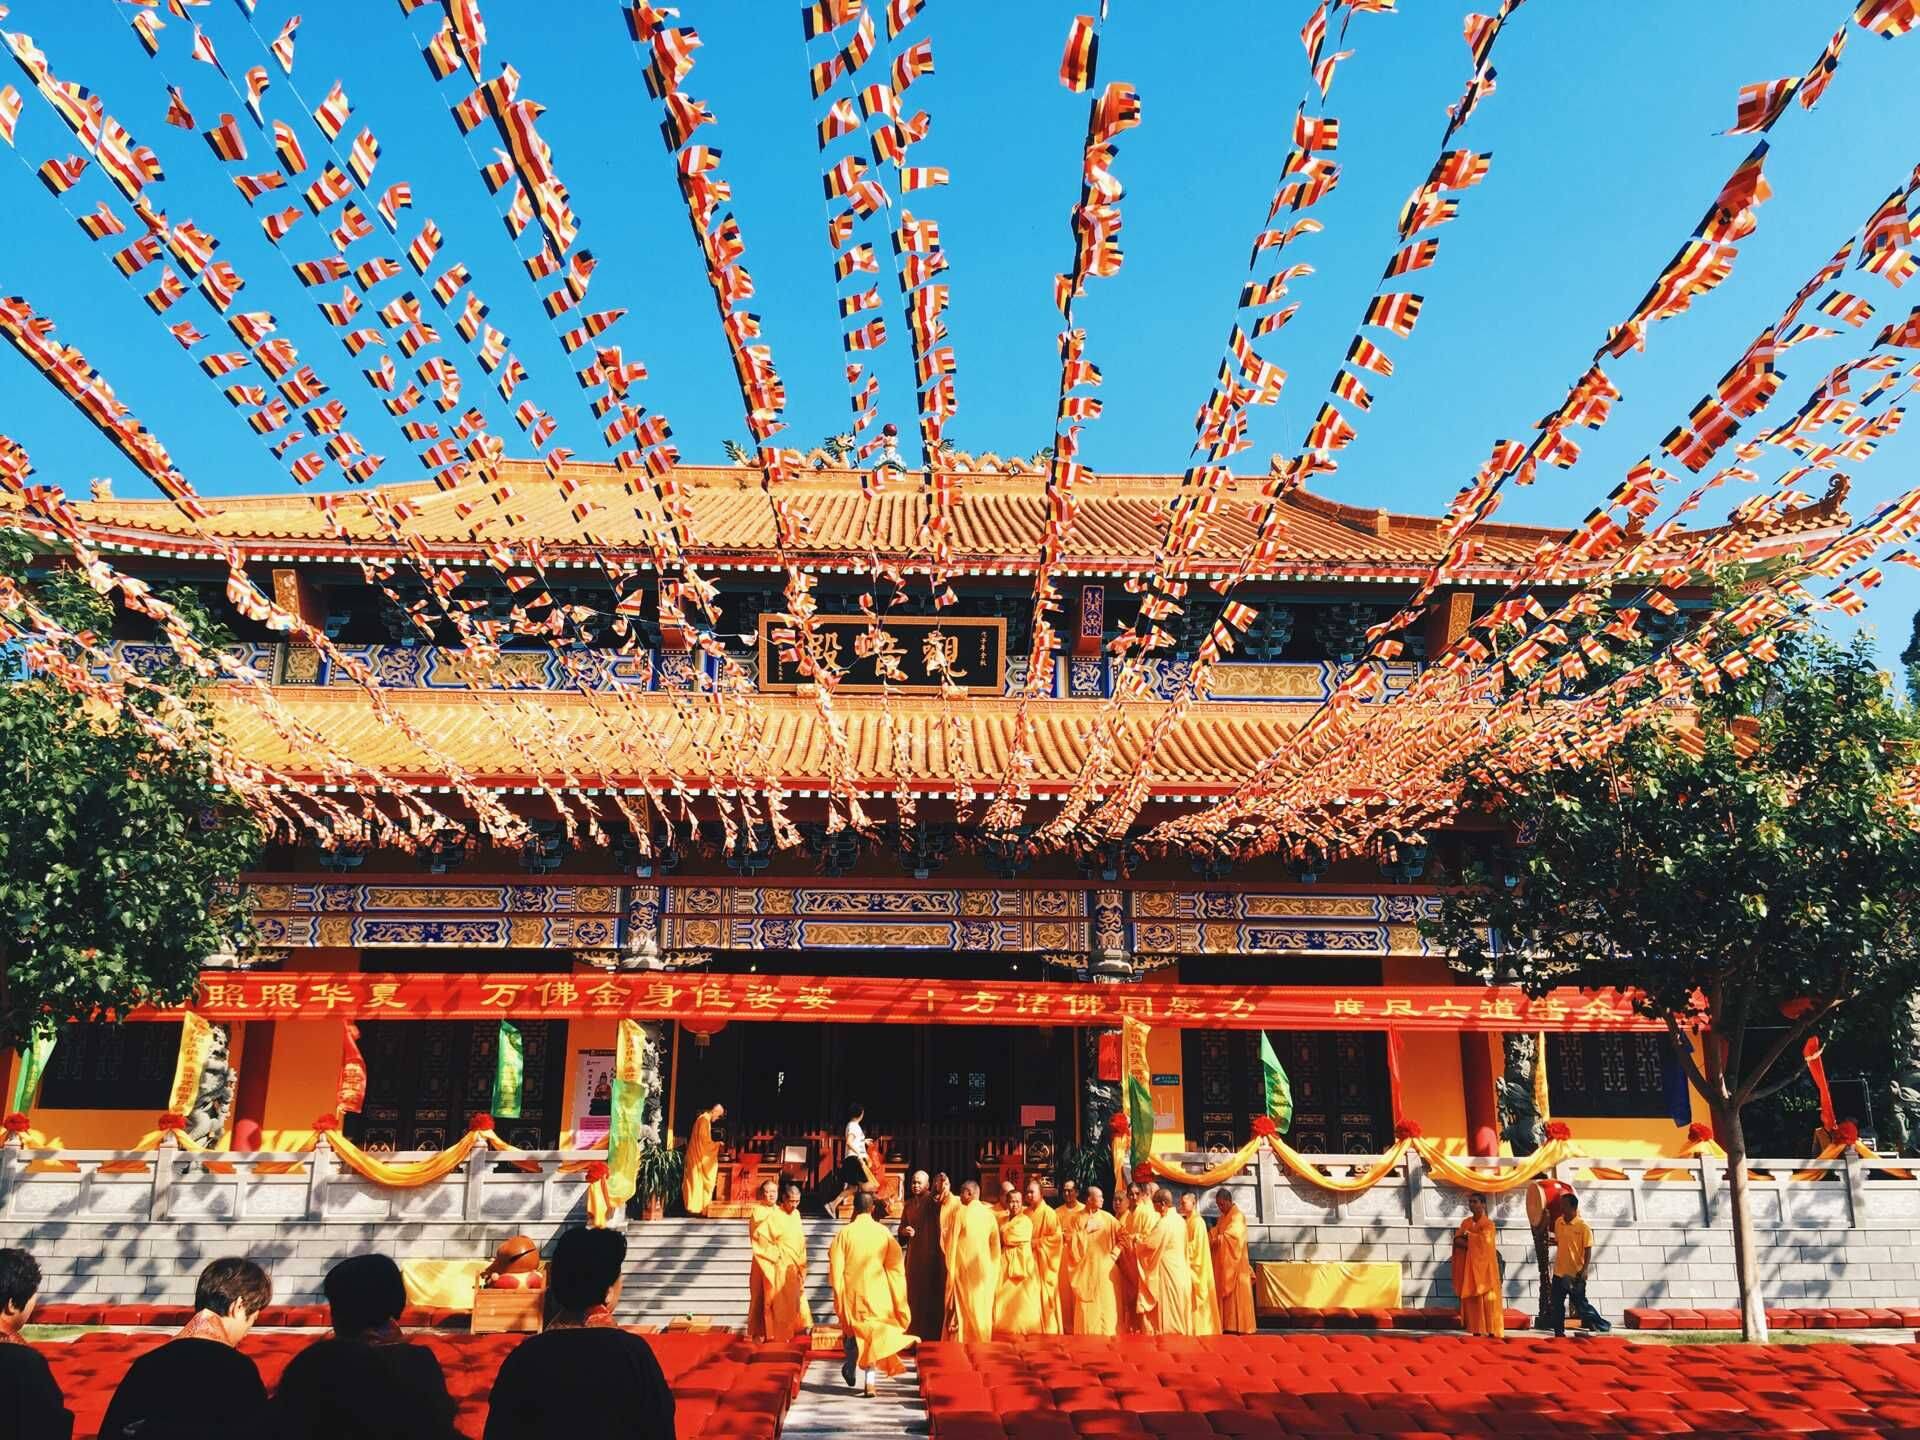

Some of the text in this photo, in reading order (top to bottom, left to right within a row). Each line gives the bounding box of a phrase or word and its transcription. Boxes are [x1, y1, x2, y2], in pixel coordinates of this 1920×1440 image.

[168, 982, 407, 1009] 照照华夏
[480, 981, 838, 1010] 万佛金身住娑婆
[1333, 995, 1656, 1021] 度尽六道苦众
